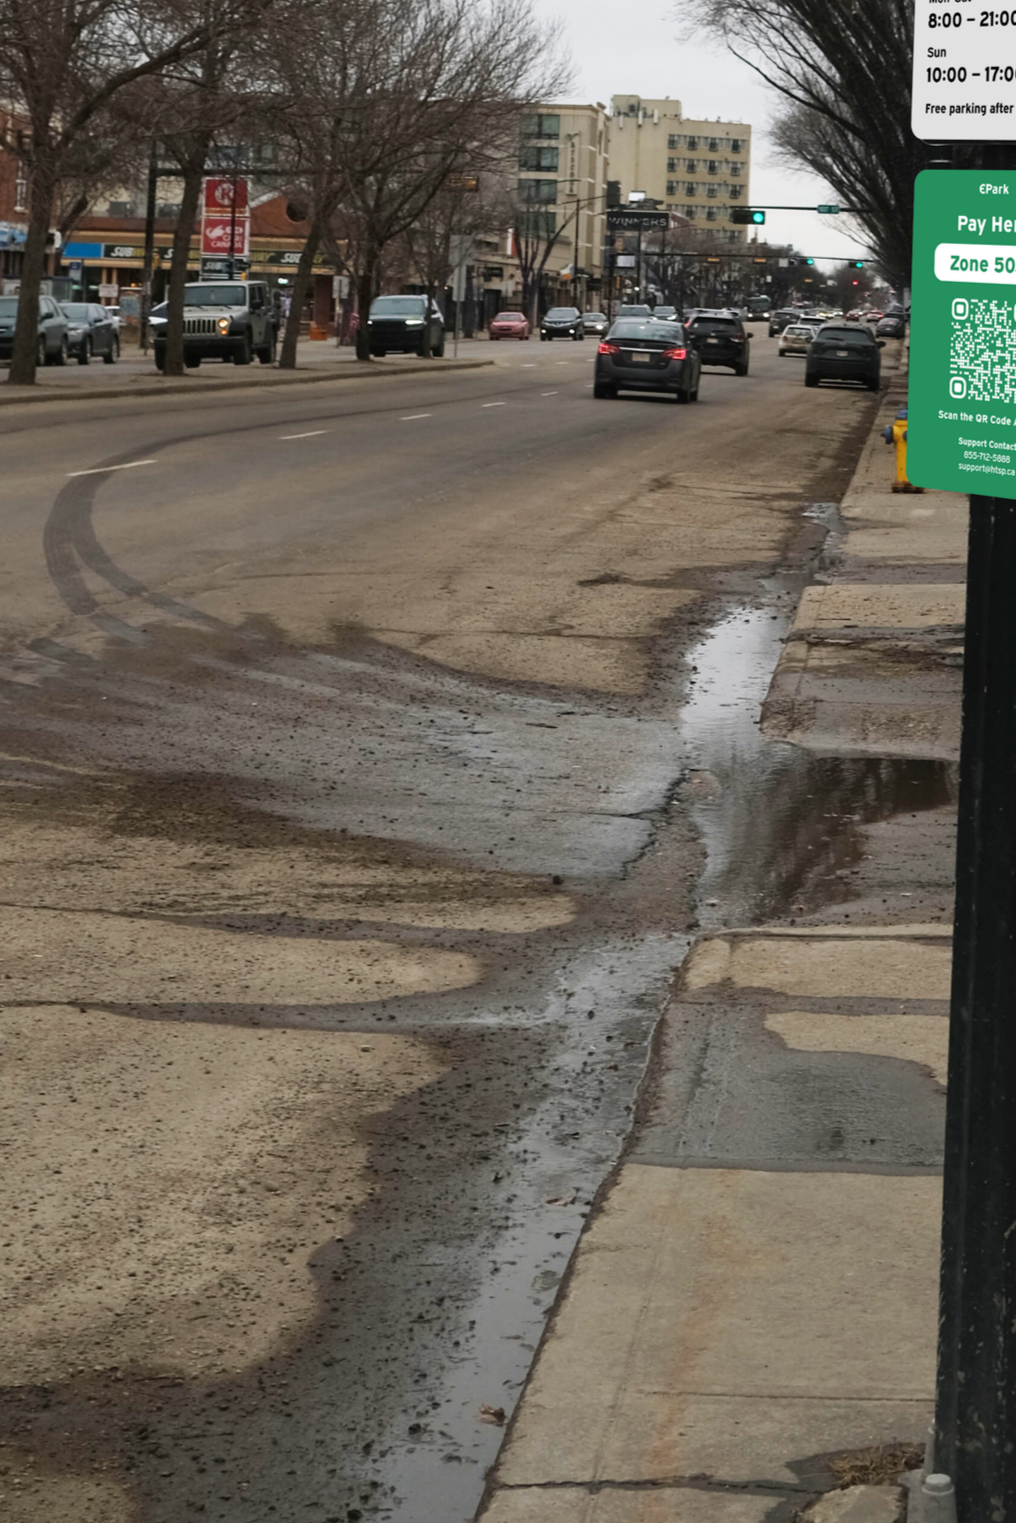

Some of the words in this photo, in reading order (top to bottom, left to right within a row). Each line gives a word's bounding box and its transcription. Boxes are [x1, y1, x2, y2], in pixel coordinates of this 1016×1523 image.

[928, 12, 962, 29] 8:00
[927, 47, 947, 59] Sun
[926, 66, 968, 83] 10:00
[925, 103, 947, 114] Free
[949, 102, 987, 117] parking
[989, 102, 1014, 114] after
[957, 215, 987, 236] Pay
[949, 255, 989, 273] Zone
[938, 410, 958, 421] Scan
[960, 411, 974, 422] the
[975, 413, 988, 424] QR
[990, 415, 1011, 426] Code
[958, 437, 988, 448] Support
